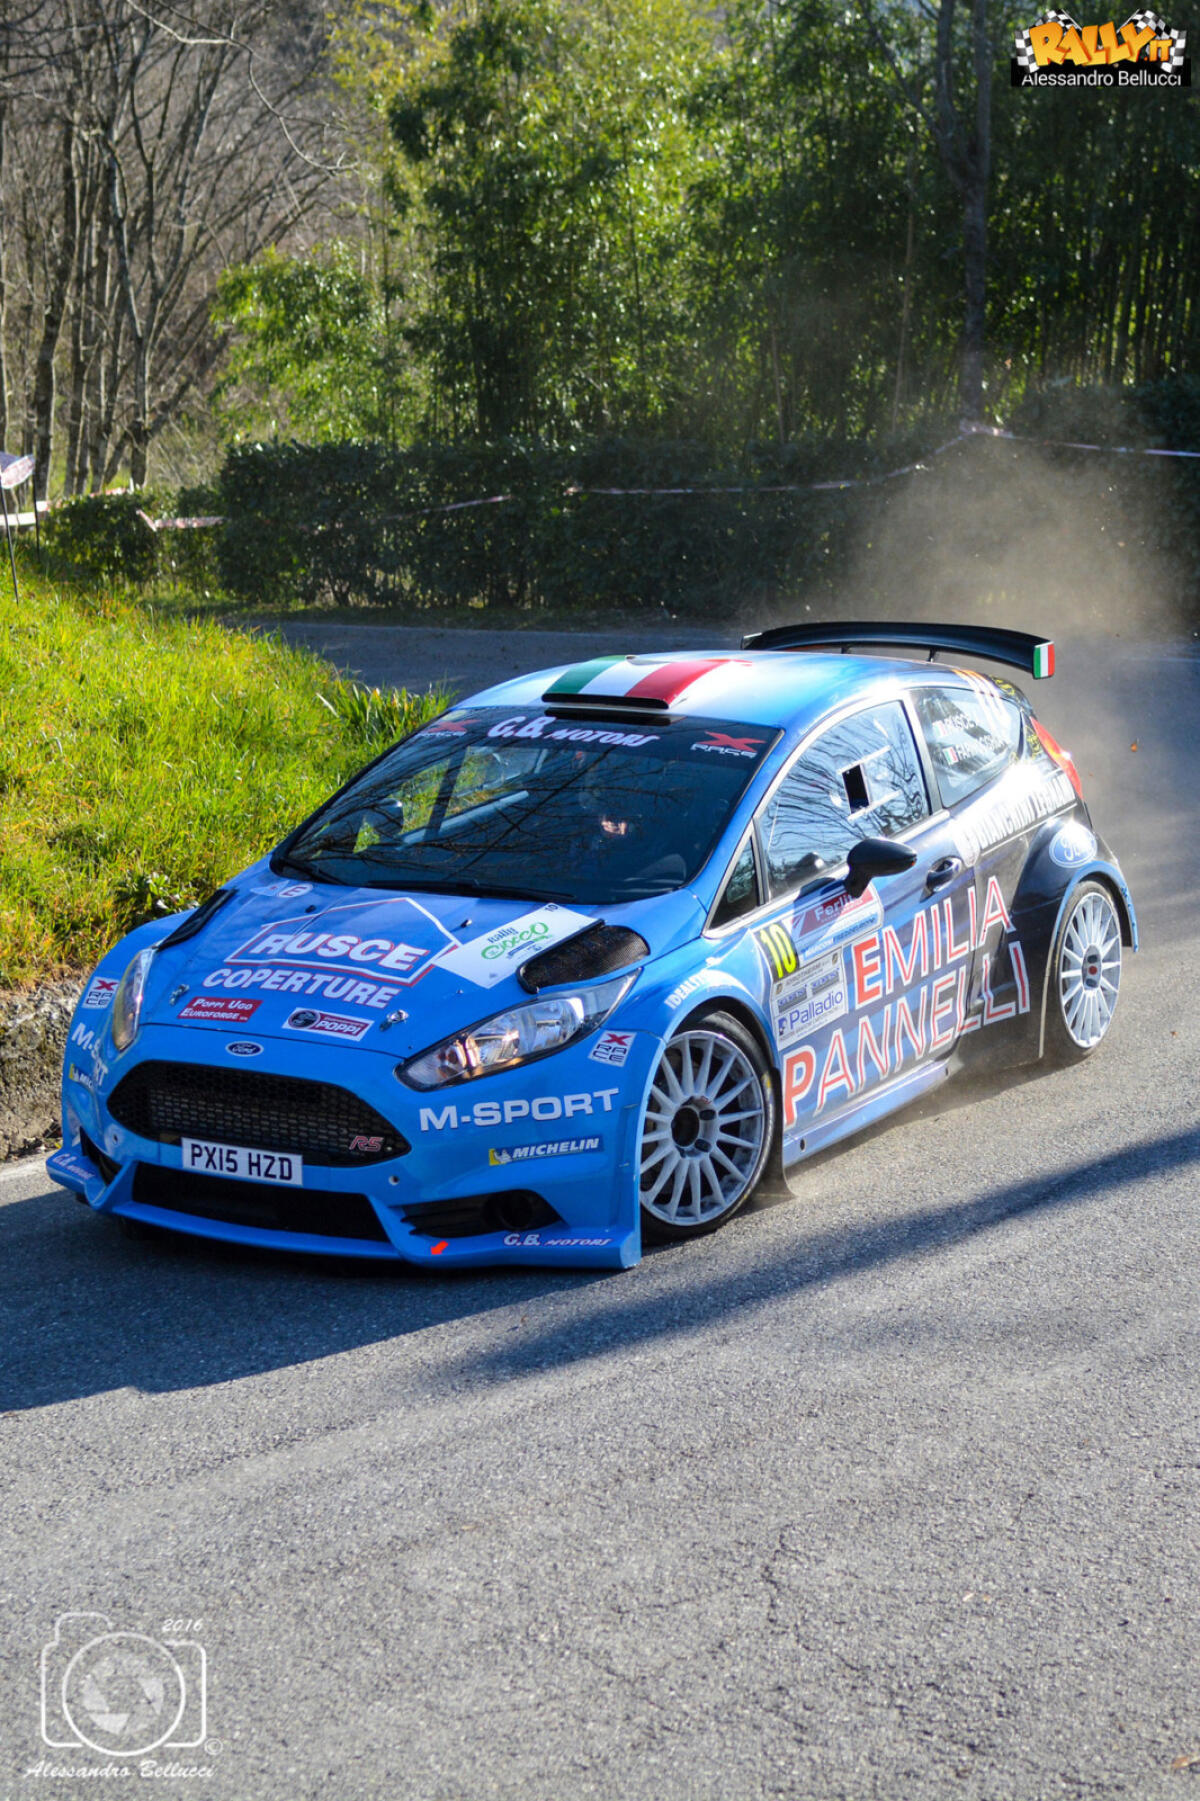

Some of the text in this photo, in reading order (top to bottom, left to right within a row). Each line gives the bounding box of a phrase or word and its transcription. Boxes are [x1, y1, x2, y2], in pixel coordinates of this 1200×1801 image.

[250, 932, 430, 971] RUSCE
[760, 923, 798, 979] 10
[852, 875, 1016, 1010] EMILIA
[203, 968, 401, 1009] COPERTURE
[316, 1020, 361, 1035] POPPI
[789, 990, 843, 1030] Palladio
[782, 940, 1031, 1130] PANNELLI
[419, 1087, 620, 1132] M-SPORT
[190, 1143, 293, 1181] PX15 HZD
[349, 1135, 384, 1152] RS
[512, 1137, 600, 1159] MICHELIN
